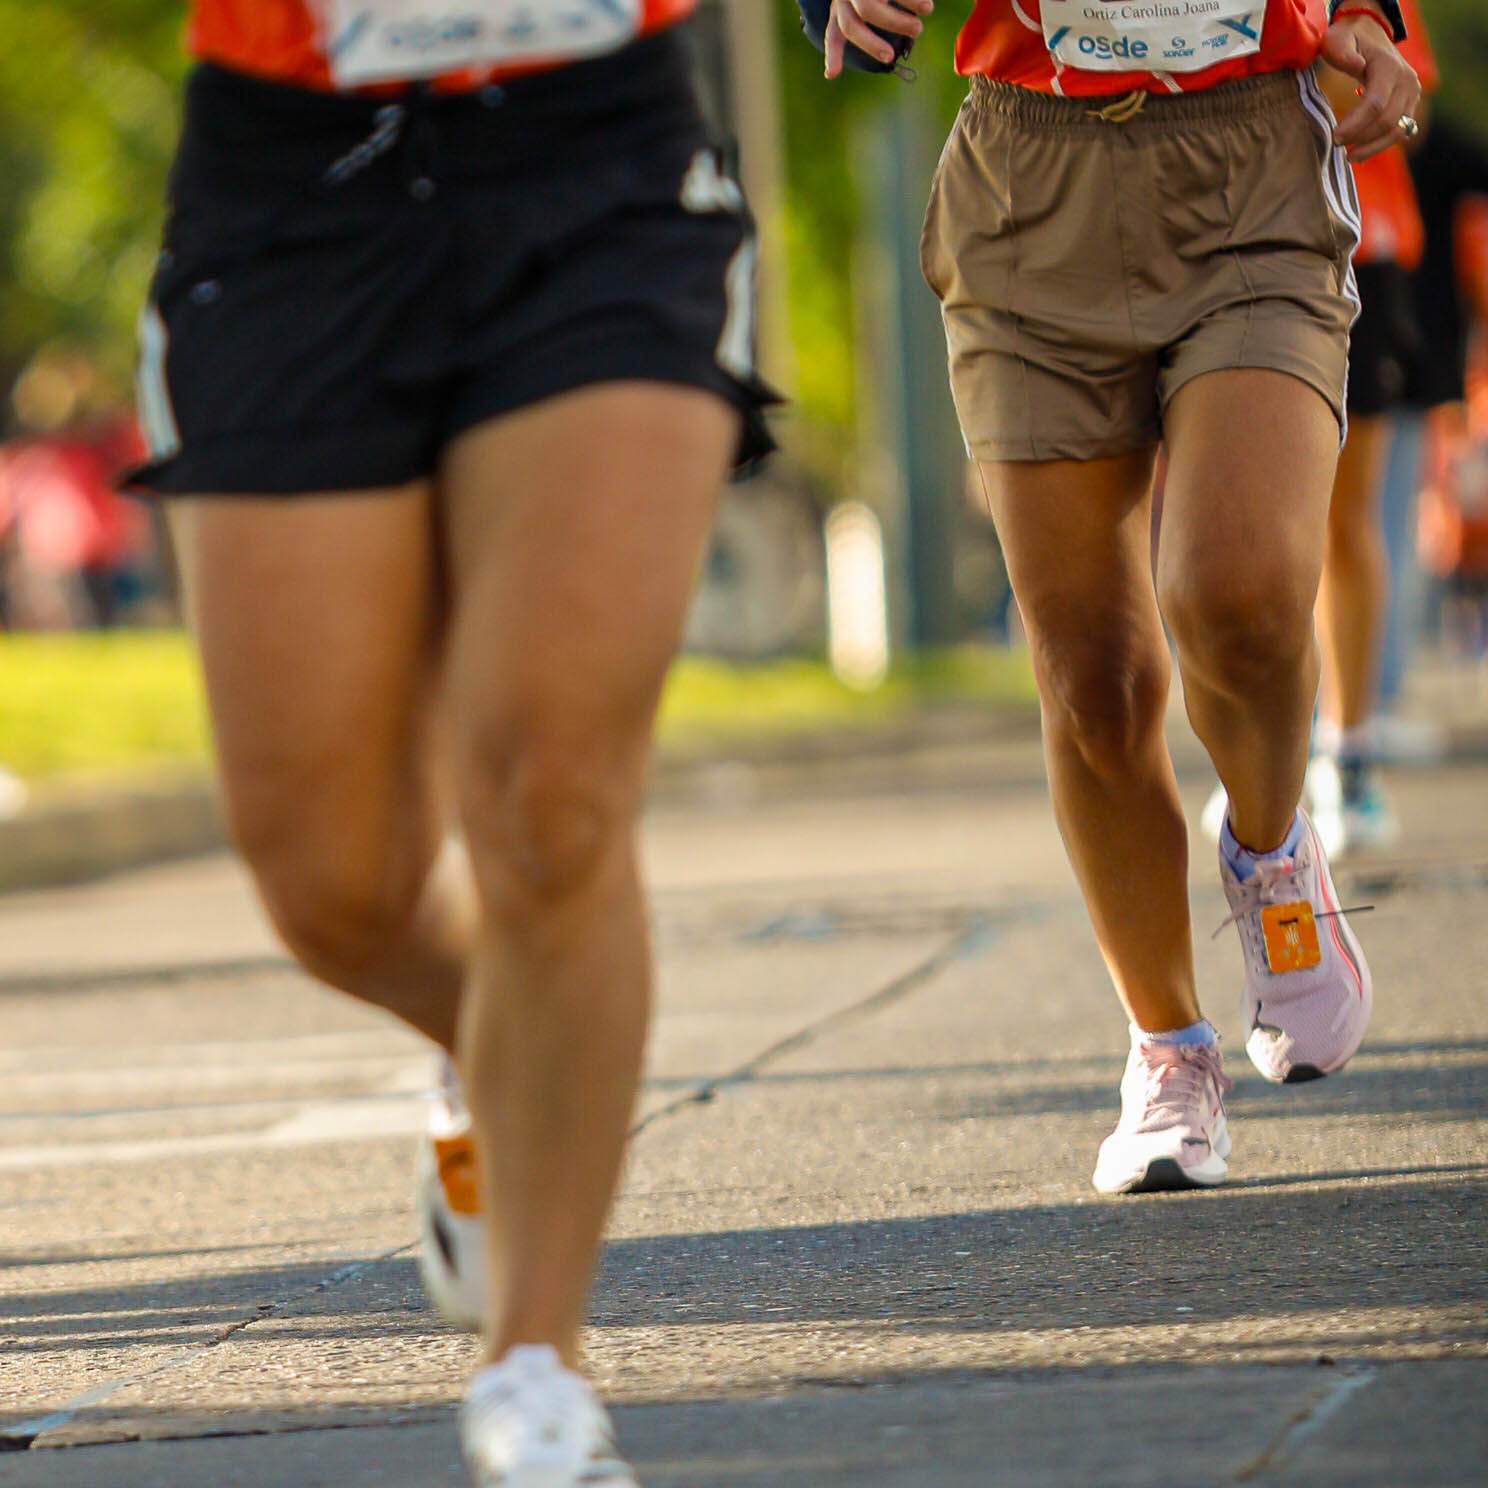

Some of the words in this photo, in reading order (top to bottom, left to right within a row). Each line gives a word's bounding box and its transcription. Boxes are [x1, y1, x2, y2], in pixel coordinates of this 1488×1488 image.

[1083, 7, 1117, 21] Ortiz
[1121, 2, 1180, 19] Carolina
[1183, 0, 1221, 16] Joana
[1078, 34, 1149, 59] osde
